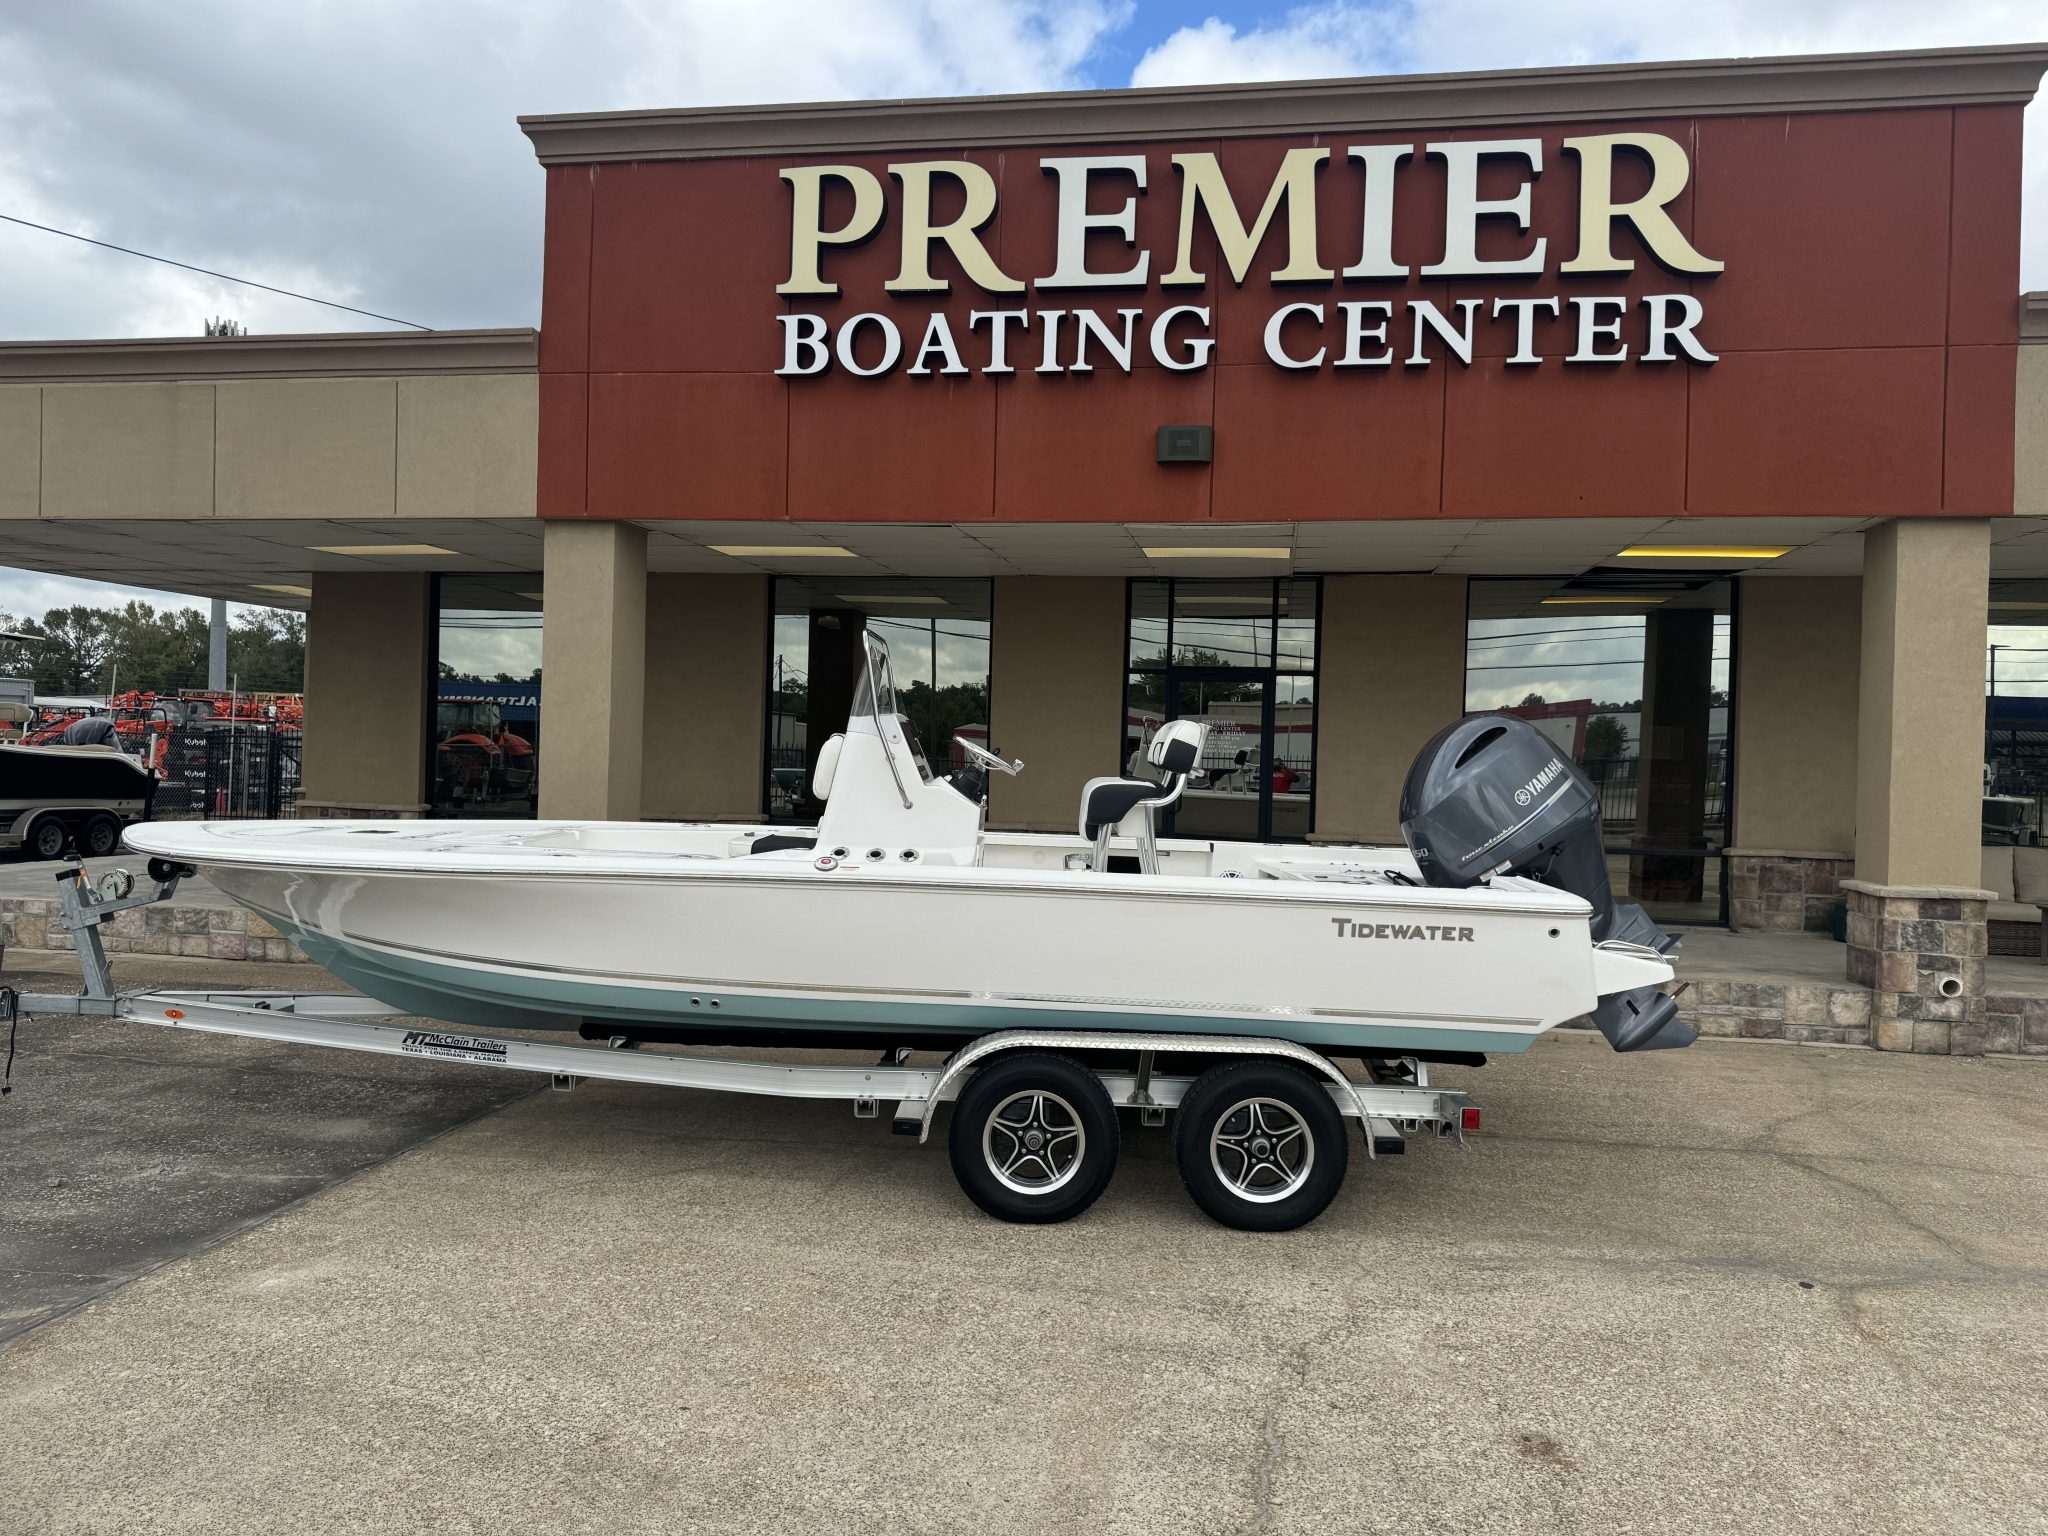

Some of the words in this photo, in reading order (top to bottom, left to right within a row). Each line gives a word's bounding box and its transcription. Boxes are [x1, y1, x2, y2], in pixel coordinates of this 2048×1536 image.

[776, 132, 1725, 295] PREMIER
[775, 305, 1214, 377] BOATING
[1264, 293, 1719, 370] CENTER
[1525, 758, 1565, 796] YAMAHA
[1331, 917, 1475, 942] TIDEWATER
[402, 1031, 431, 1046] MT
[429, 1034, 469, 1047] McClain
[472, 1038, 507, 1051] Trailers
[430, 1050, 467, 1059] LOUISIANA
[474, 1055, 507, 1063] ALABAMA
